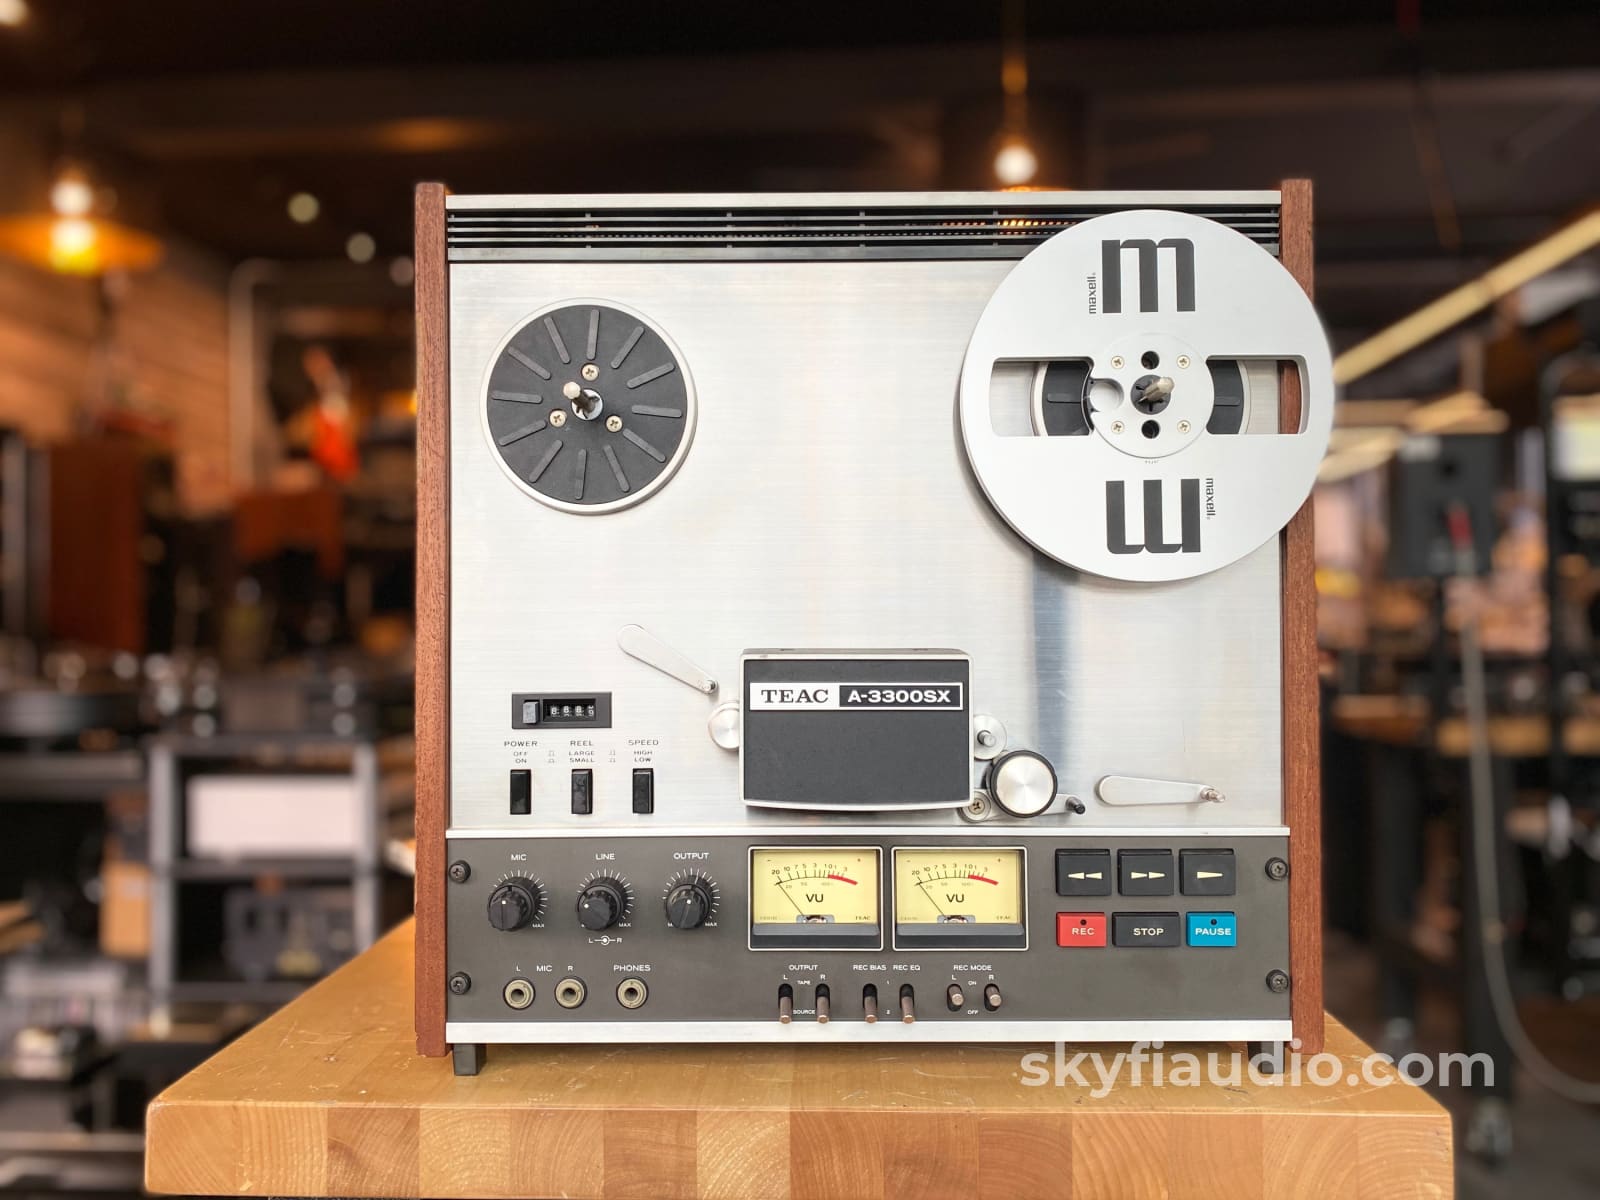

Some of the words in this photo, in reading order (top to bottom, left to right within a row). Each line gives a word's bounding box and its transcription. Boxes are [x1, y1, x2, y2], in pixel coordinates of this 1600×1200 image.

[1087, 276, 1096, 314] maxell
[1206, 478, 1216, 516] maxell
[761, 689, 829, 703] TEAC
[848, 690, 951, 703] A-3300SX
[673, 852, 709, 860] OUTPUT
[806, 894, 824, 903] VU
[946, 894, 964, 903] VU
